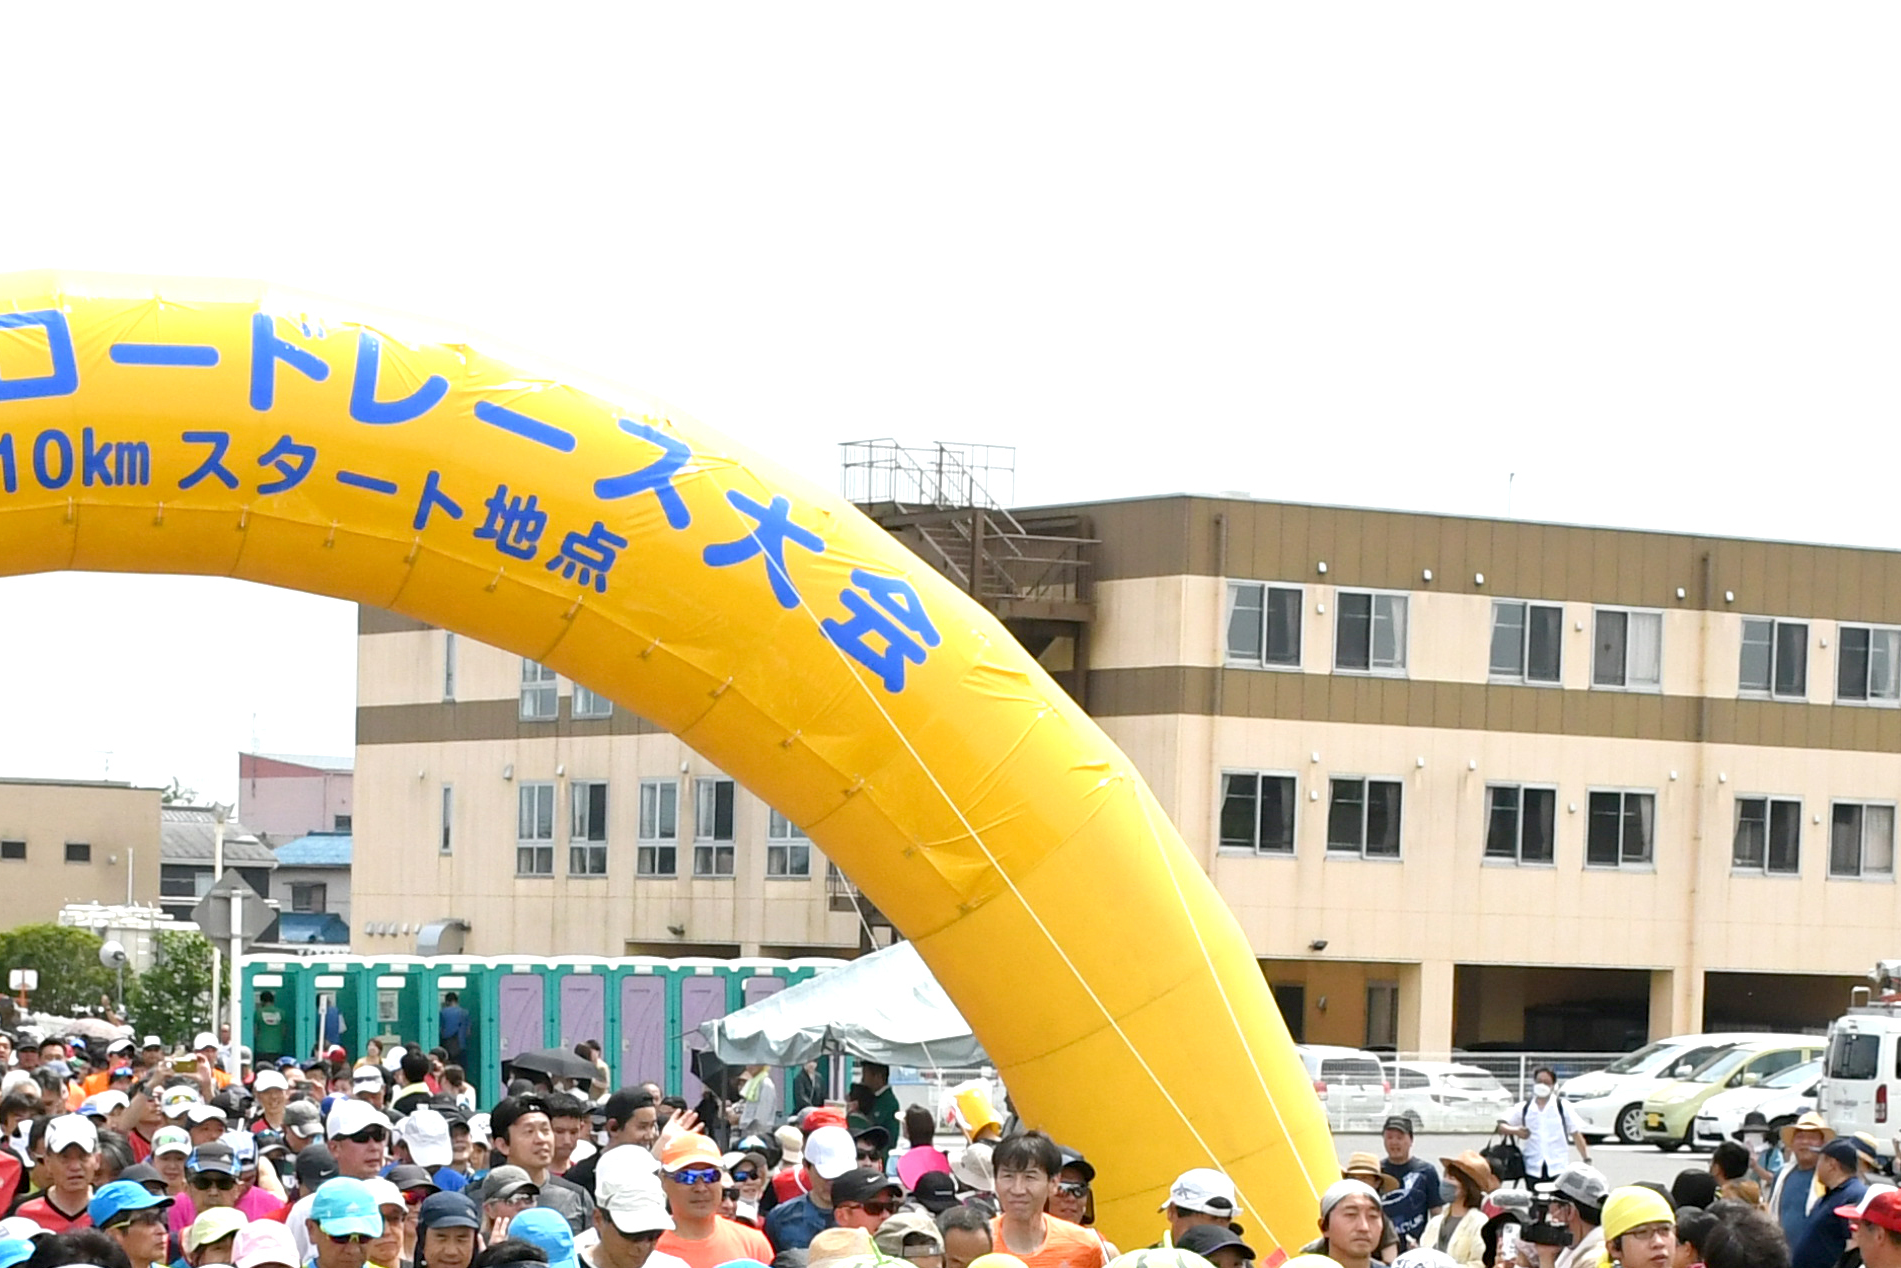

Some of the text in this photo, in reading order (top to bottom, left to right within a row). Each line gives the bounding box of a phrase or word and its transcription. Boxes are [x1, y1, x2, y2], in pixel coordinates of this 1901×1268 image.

[178, 431, 628, 594] スタート地点
